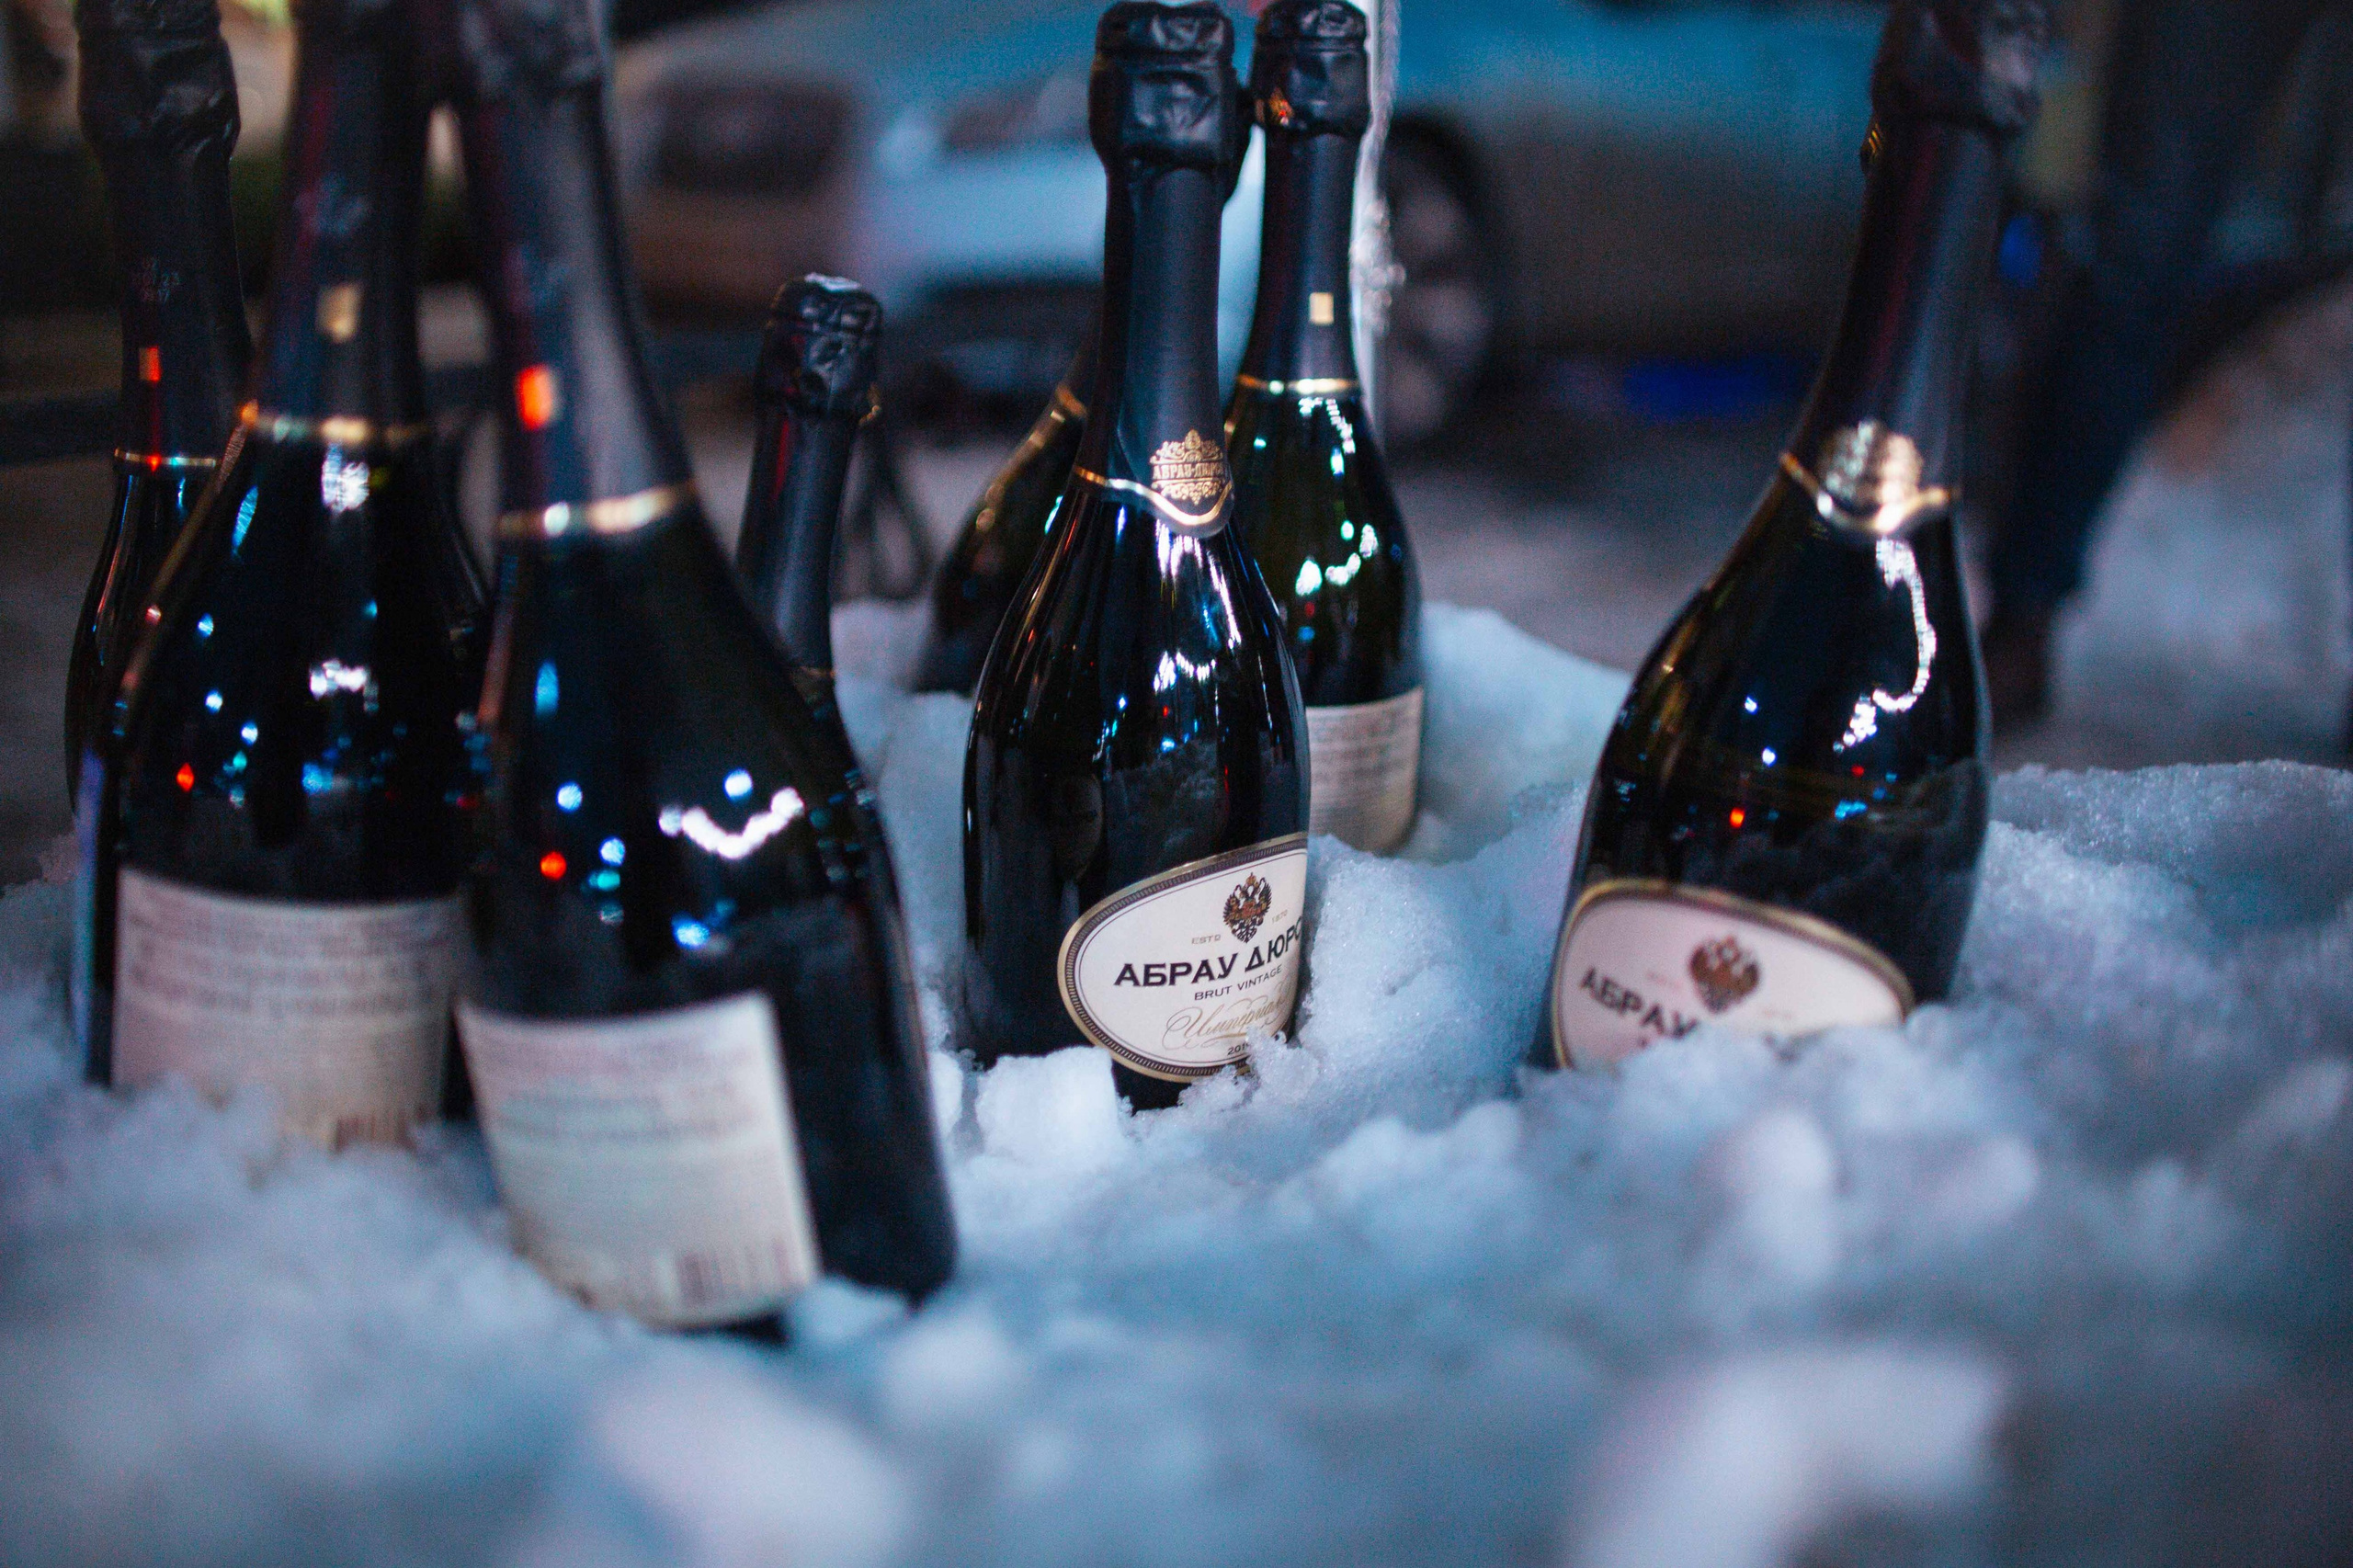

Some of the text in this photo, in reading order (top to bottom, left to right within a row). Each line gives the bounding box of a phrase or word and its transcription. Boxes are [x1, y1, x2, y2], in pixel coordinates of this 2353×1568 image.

[1113, 952, 1239, 987] АБРАУ
[1194, 964, 1282, 1001] BRUT VINTAGE
